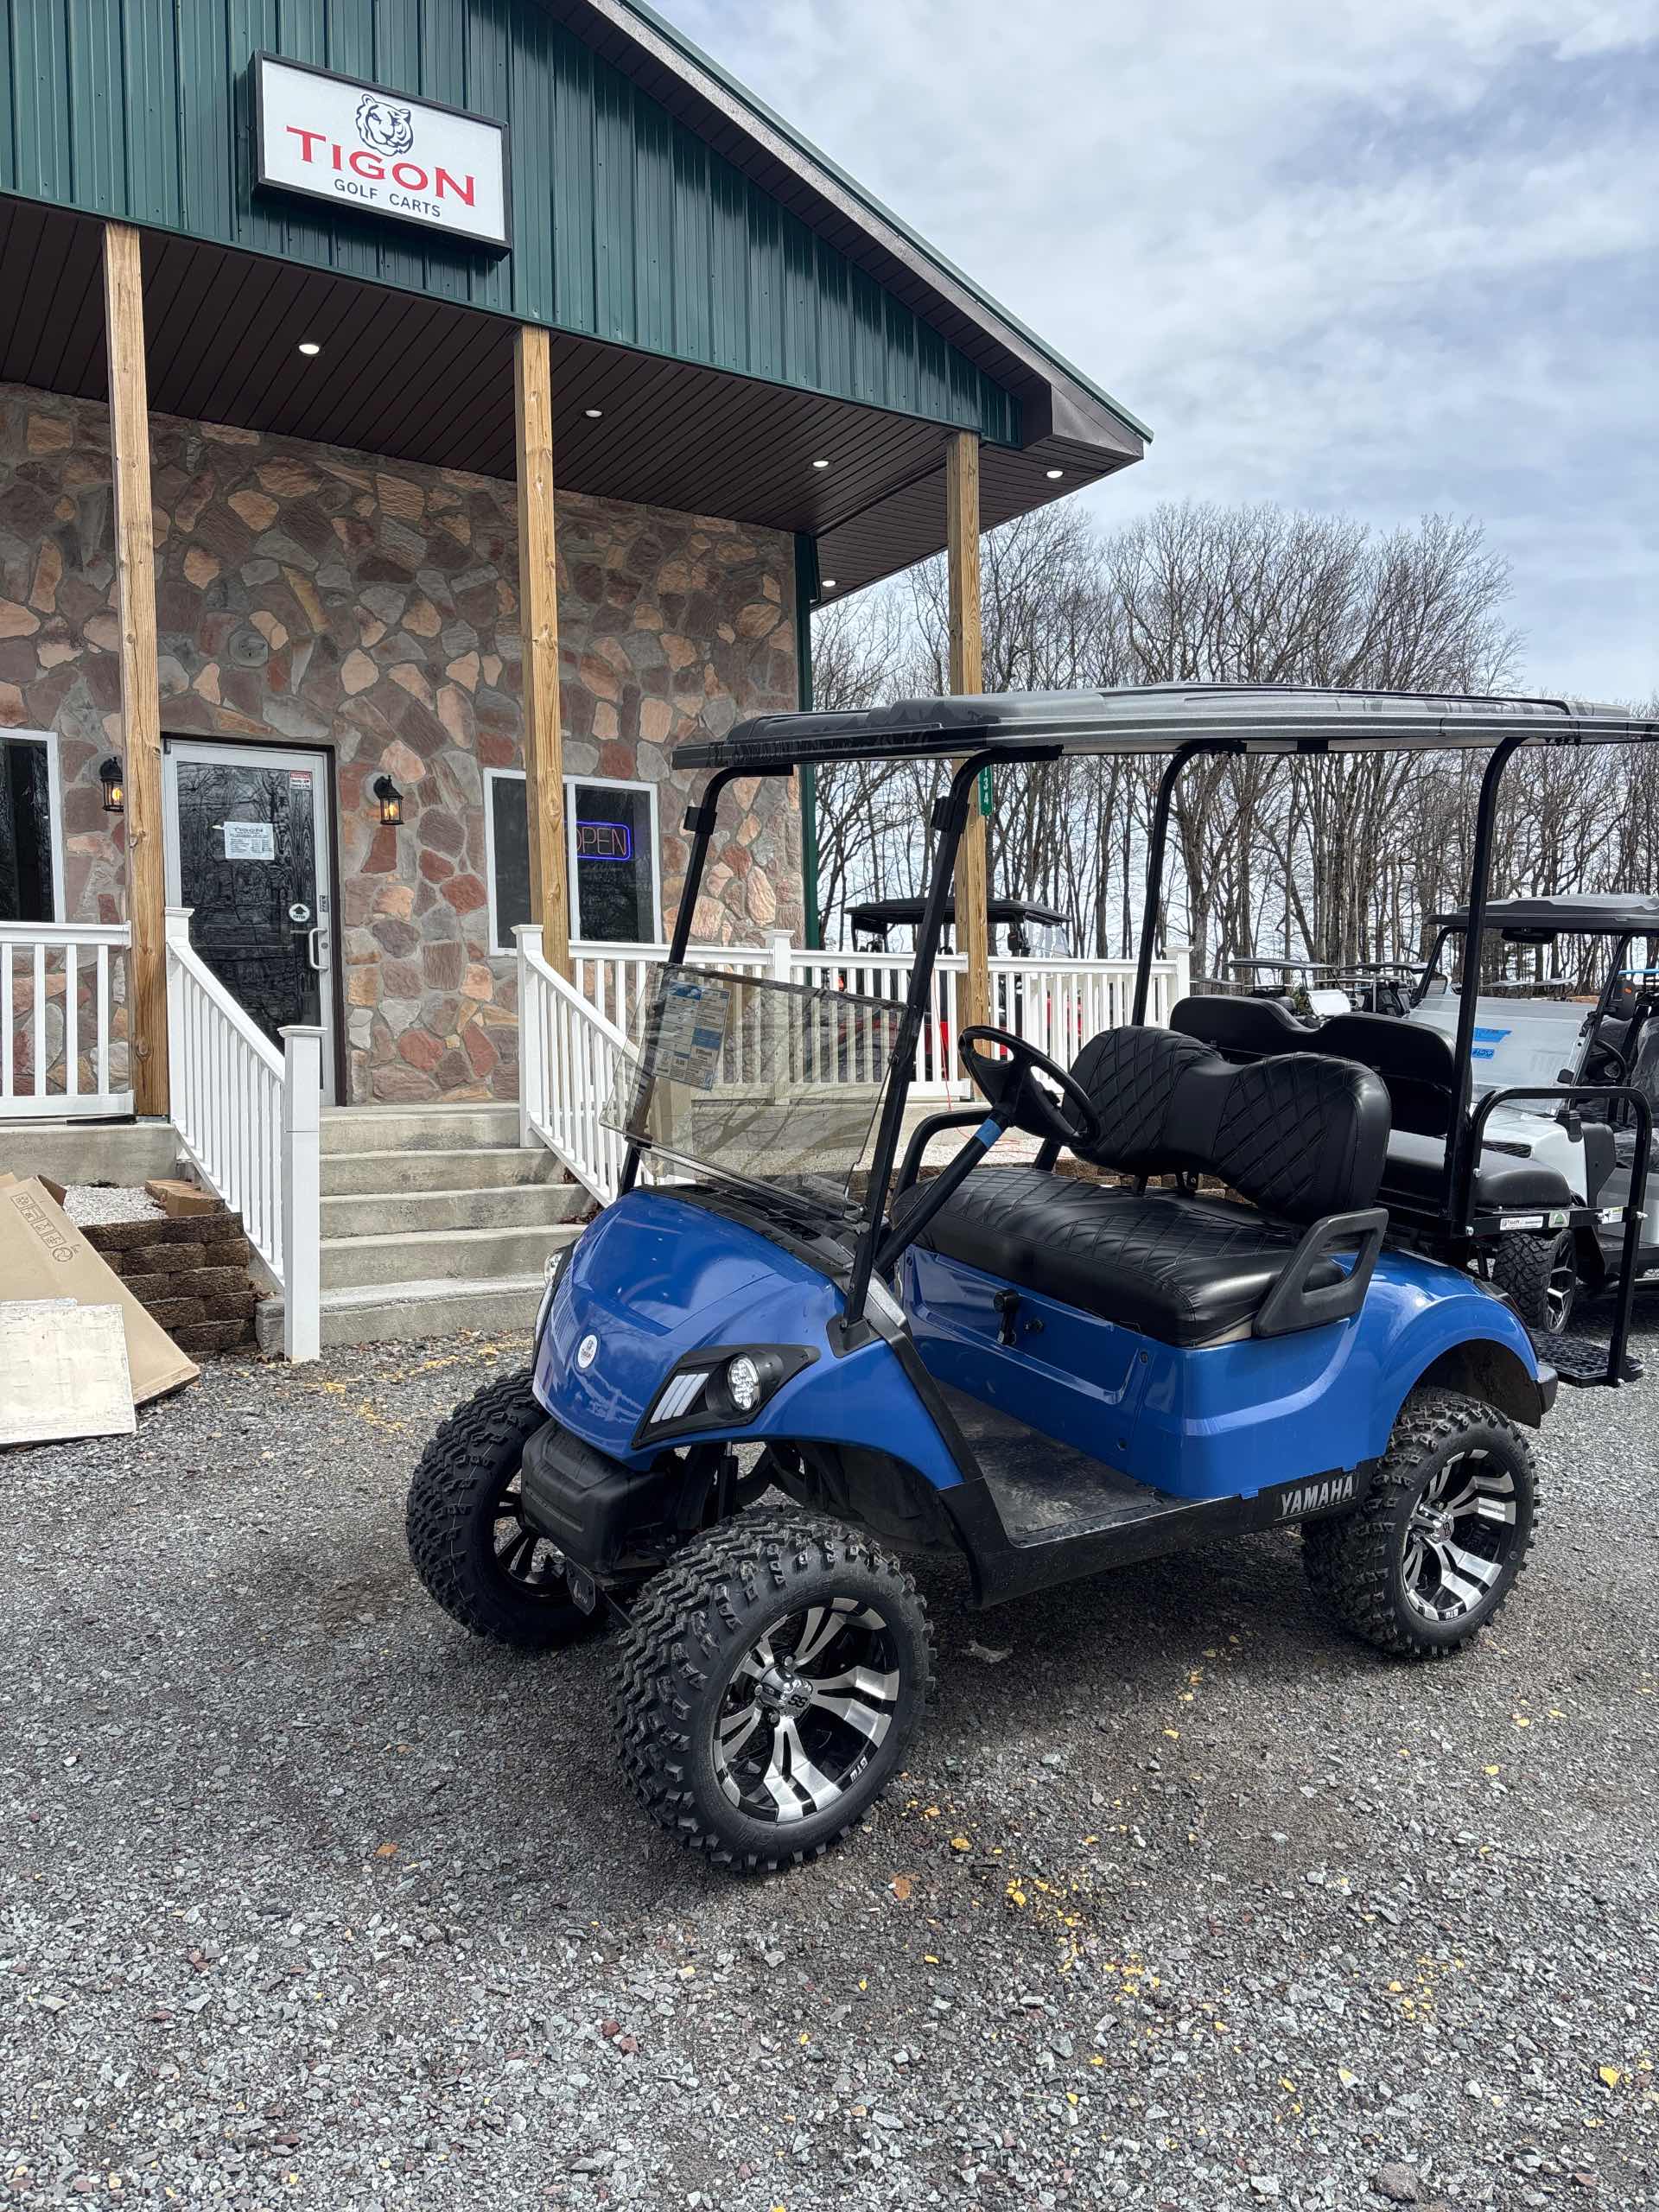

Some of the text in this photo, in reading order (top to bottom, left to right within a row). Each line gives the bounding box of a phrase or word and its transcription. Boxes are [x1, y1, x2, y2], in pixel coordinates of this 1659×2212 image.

[286, 124, 475, 207] TIGON
[334, 178, 441, 218] GOLF CARTS
[1281, 1475, 1354, 1516] YAMAHA
